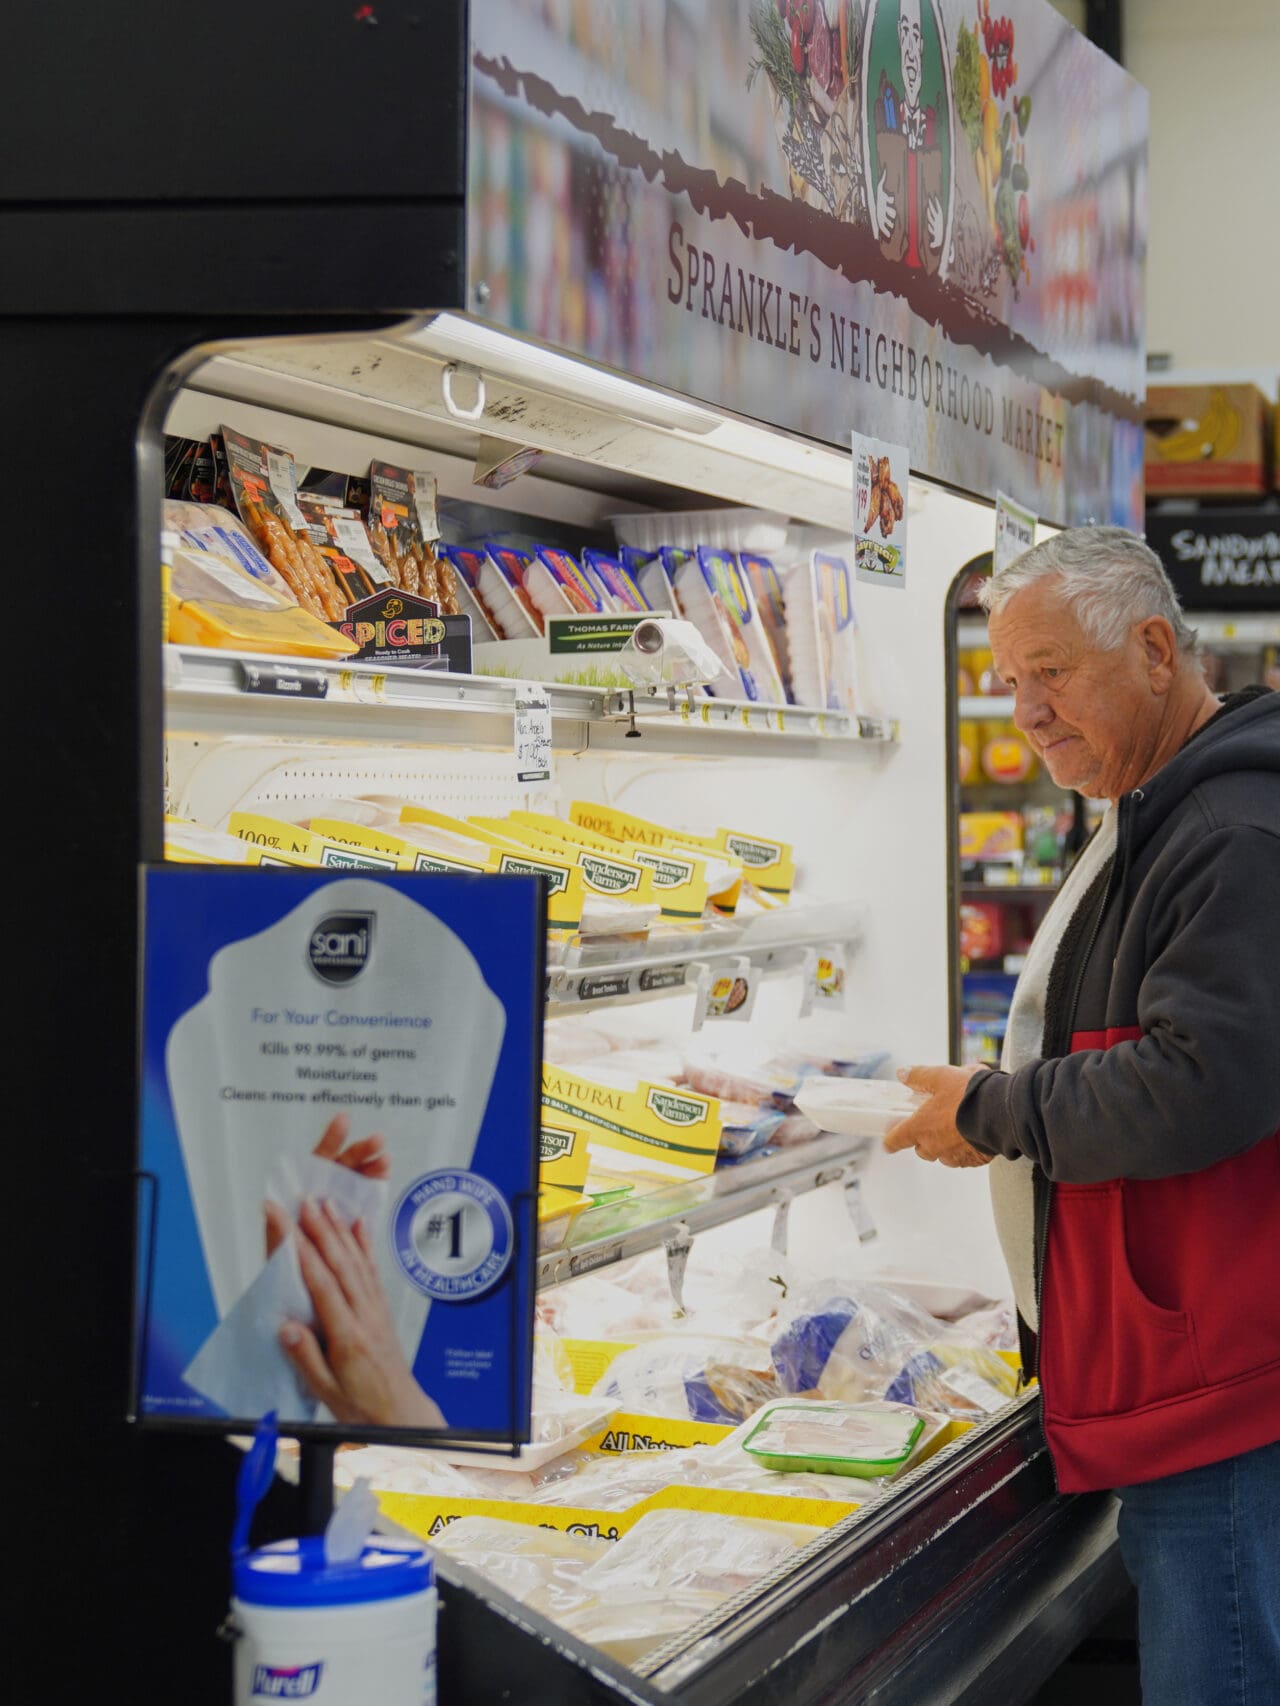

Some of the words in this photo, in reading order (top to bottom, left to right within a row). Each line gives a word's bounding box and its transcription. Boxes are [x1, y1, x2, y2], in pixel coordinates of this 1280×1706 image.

[667, 222, 823, 364] SPRANKLE'S
[830, 315, 996, 437] NEIGHBORHOOD
[1002, 396, 1063, 468] MARKET
[340, 618, 446, 647] SPICED
[568, 625, 608, 633] THOMAS
[577, 813, 616, 835] 100%
[584, 859, 634, 883] Sanderson
[592, 872, 621, 889] Farms
[311, 929, 368, 956] sani
[251, 1008, 279, 1024] For
[285, 1009, 320, 1025] Your
[324, 1010, 433, 1029] Convenience
[260, 1042, 290, 1057] Kills
[352, 1044, 367, 1058] of
[369, 1046, 417, 1062] germs
[296, 1067, 378, 1082] Moisturizes
[220, 1087, 266, 1101] Cleans
[271, 1090, 307, 1102] more
[312, 1090, 384, 1108] effectively
[388, 1093, 422, 1107] than
[425, 1096, 457, 1110] gels
[542, 1076, 625, 1112] NATURAL
[654, 1093, 703, 1115] Sanderson
[662, 1105, 691, 1121] Farms
[540, 1134, 566, 1148] erson
[411, 1176, 457, 1206] HAND
[426, 1206, 465, 1258] #1
[416, 1251, 504, 1294] HEALTHCARE
[600, 1431, 629, 1452] All
